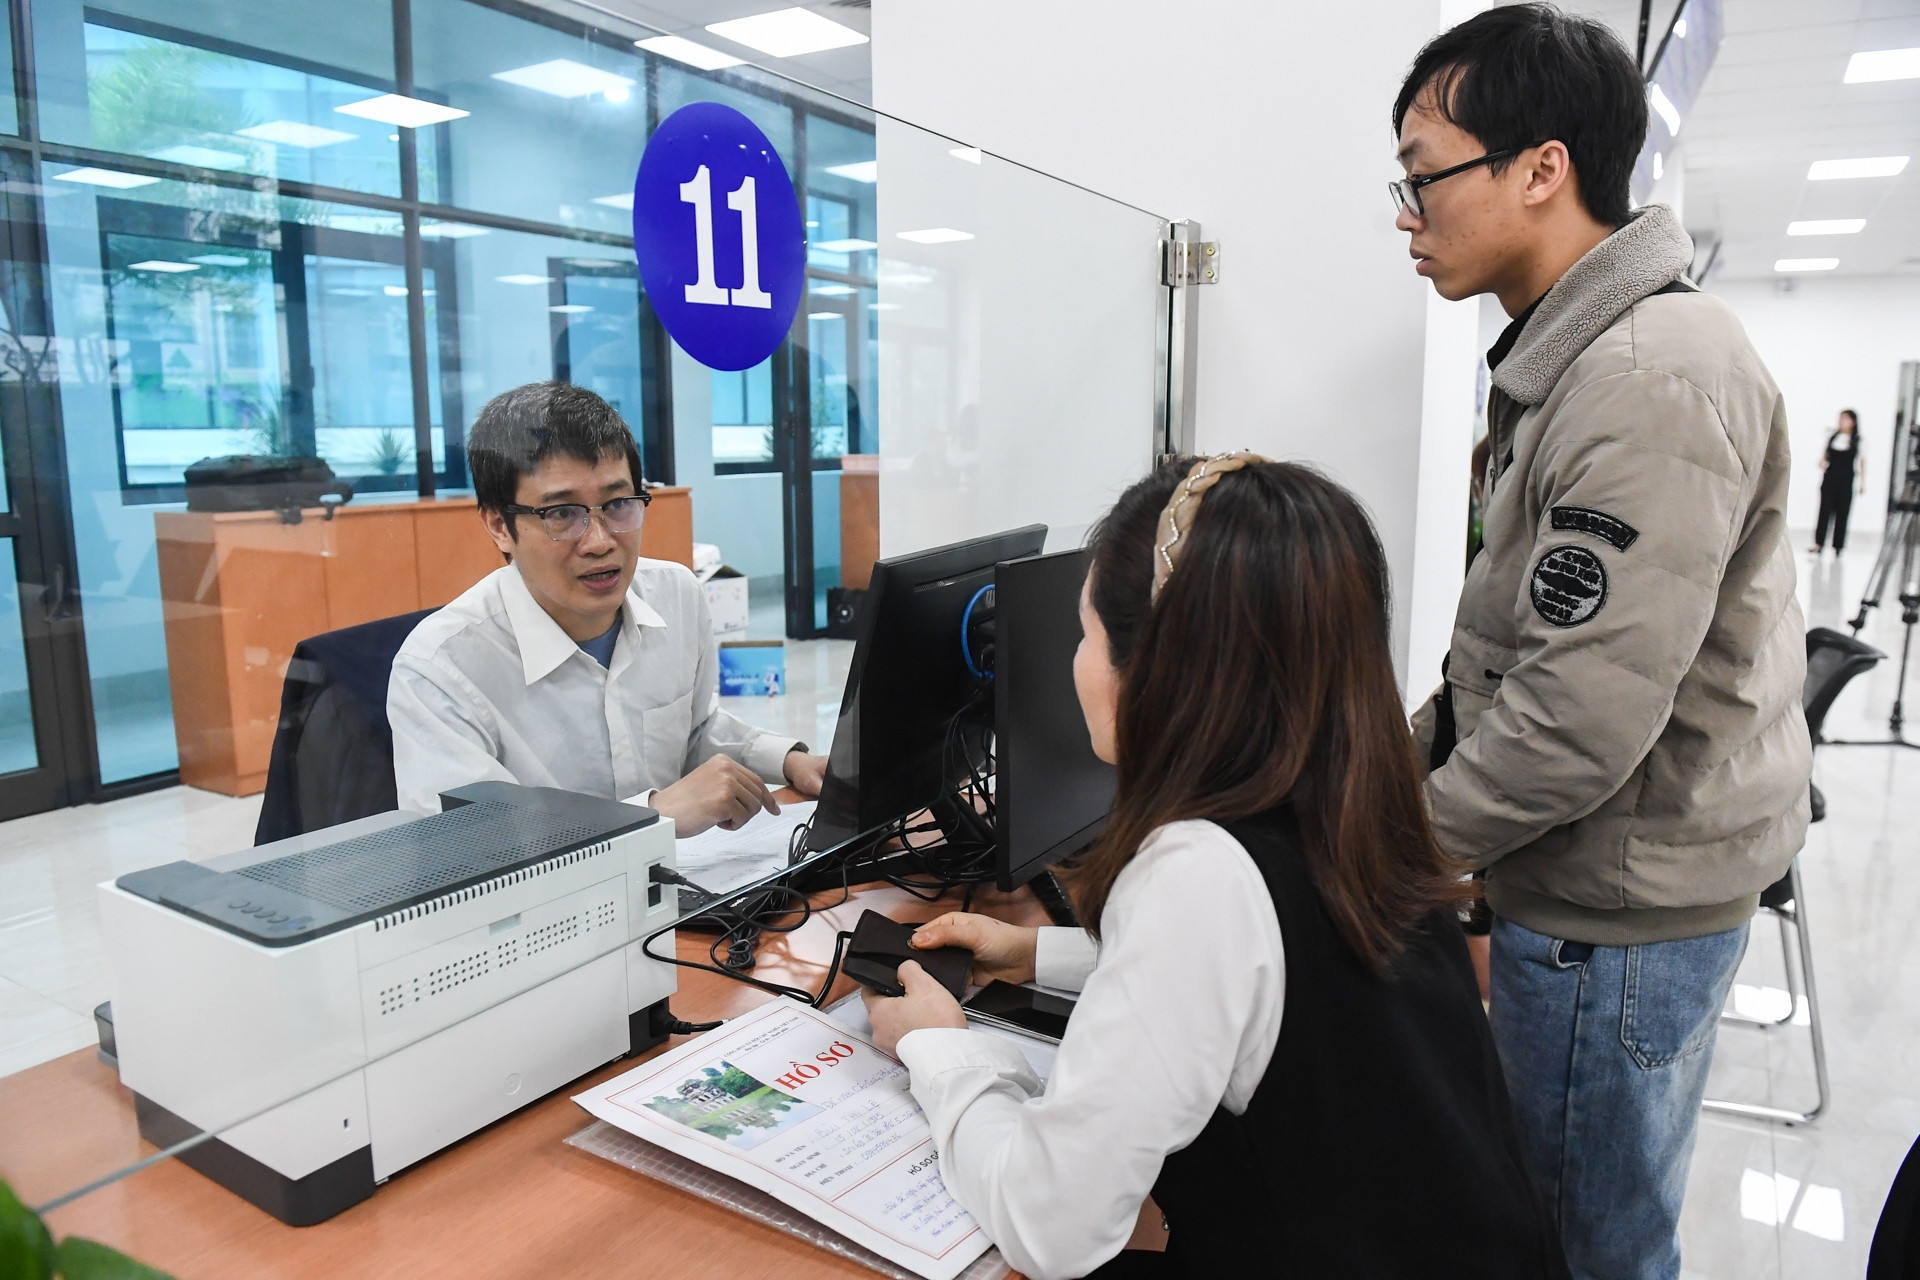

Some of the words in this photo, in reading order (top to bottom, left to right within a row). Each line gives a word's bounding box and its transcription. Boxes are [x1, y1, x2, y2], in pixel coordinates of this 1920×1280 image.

[680, 164, 772, 309] 11
[774, 1061, 821, 1091] HỒ
[816, 1041, 854, 1067] SƠ
